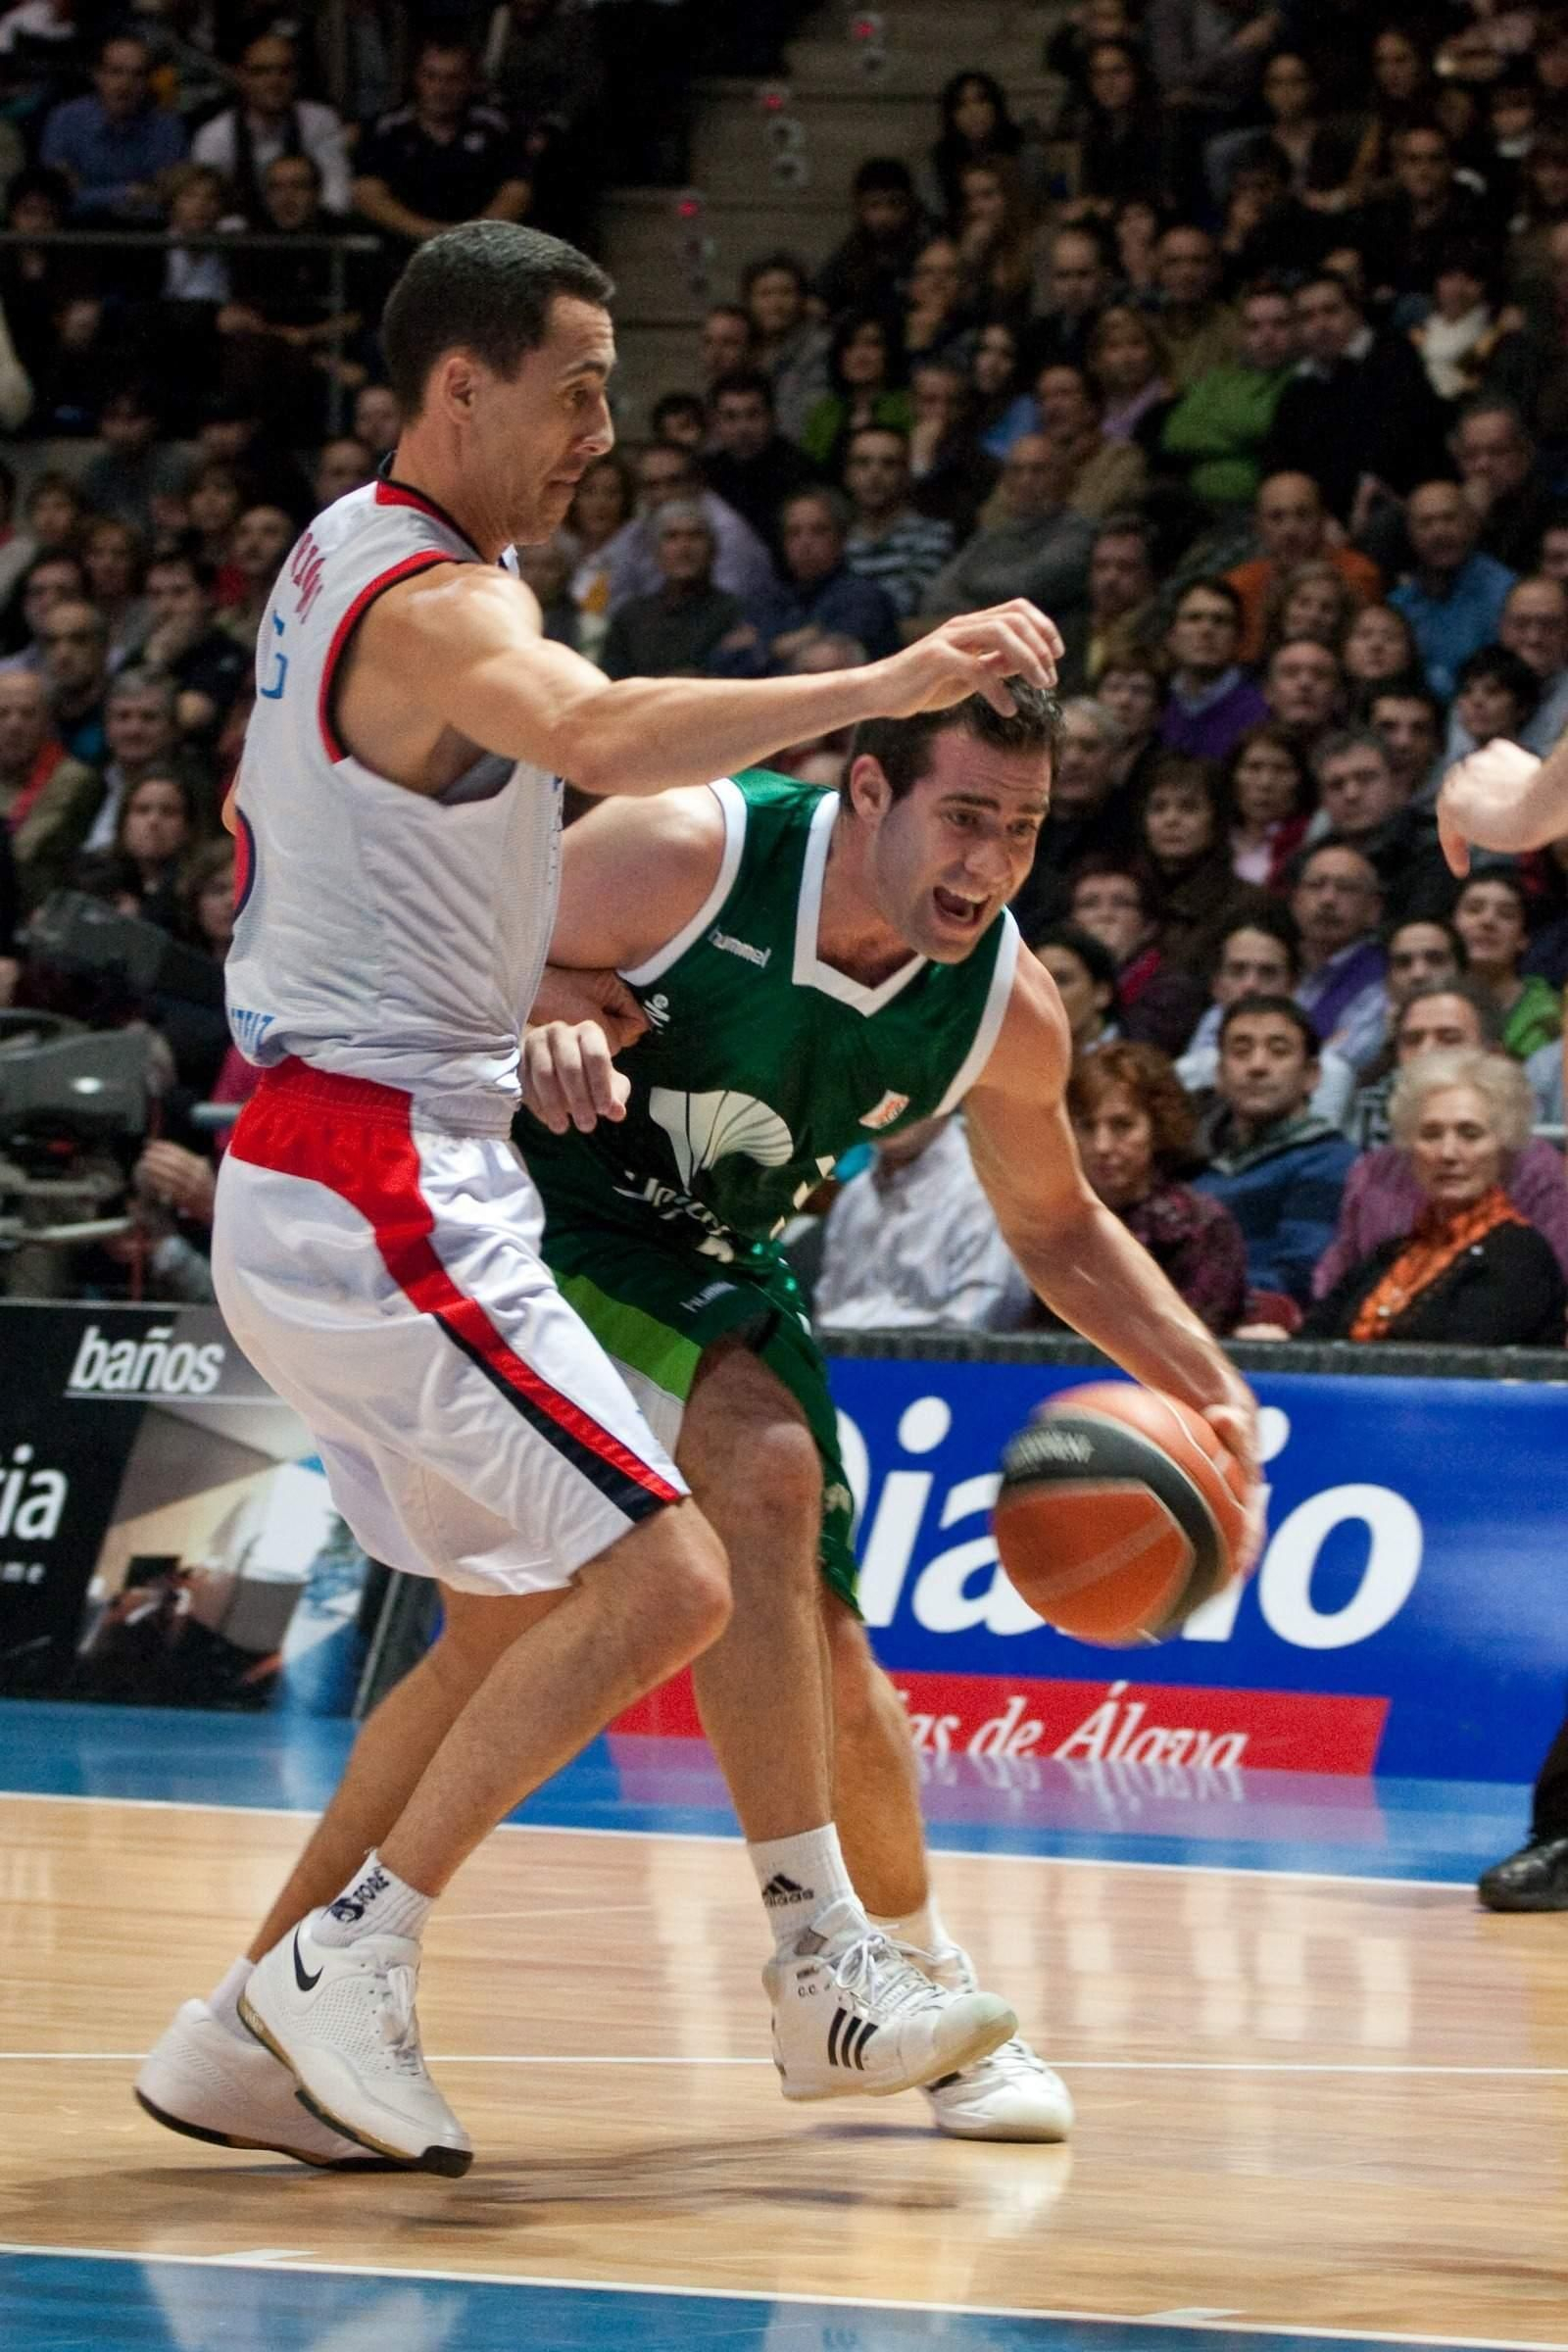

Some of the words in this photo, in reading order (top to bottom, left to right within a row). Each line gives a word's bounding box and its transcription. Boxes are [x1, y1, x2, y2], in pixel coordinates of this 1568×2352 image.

[68, 1325, 226, 1394] baños
[967, 1694, 1045, 1758] de
[1053, 1680, 1250, 1768] Álava
